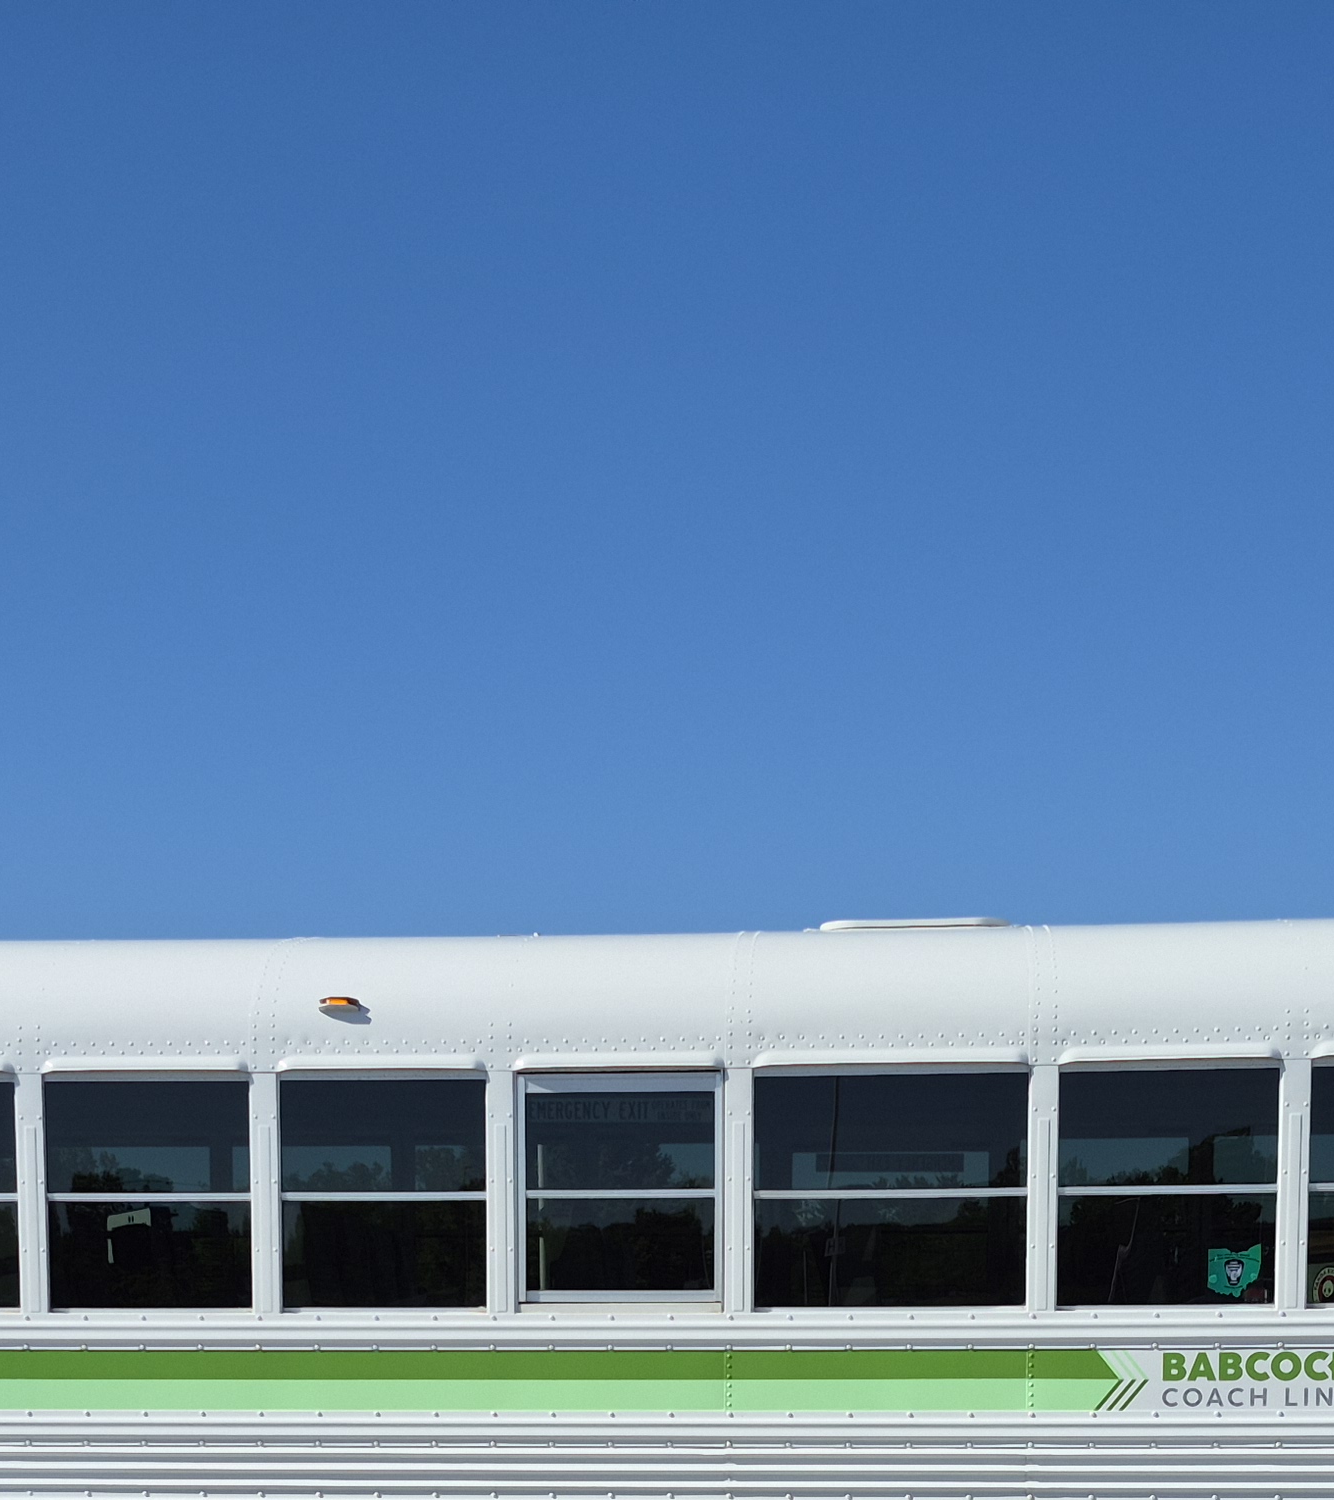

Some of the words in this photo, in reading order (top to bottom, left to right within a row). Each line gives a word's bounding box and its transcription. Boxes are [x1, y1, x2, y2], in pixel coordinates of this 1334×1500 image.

[528, 1100, 610, 1120] EMERGENCY
[619, 1100, 649, 1120] EXIT
[1161, 1386, 1268, 1408] COACH
